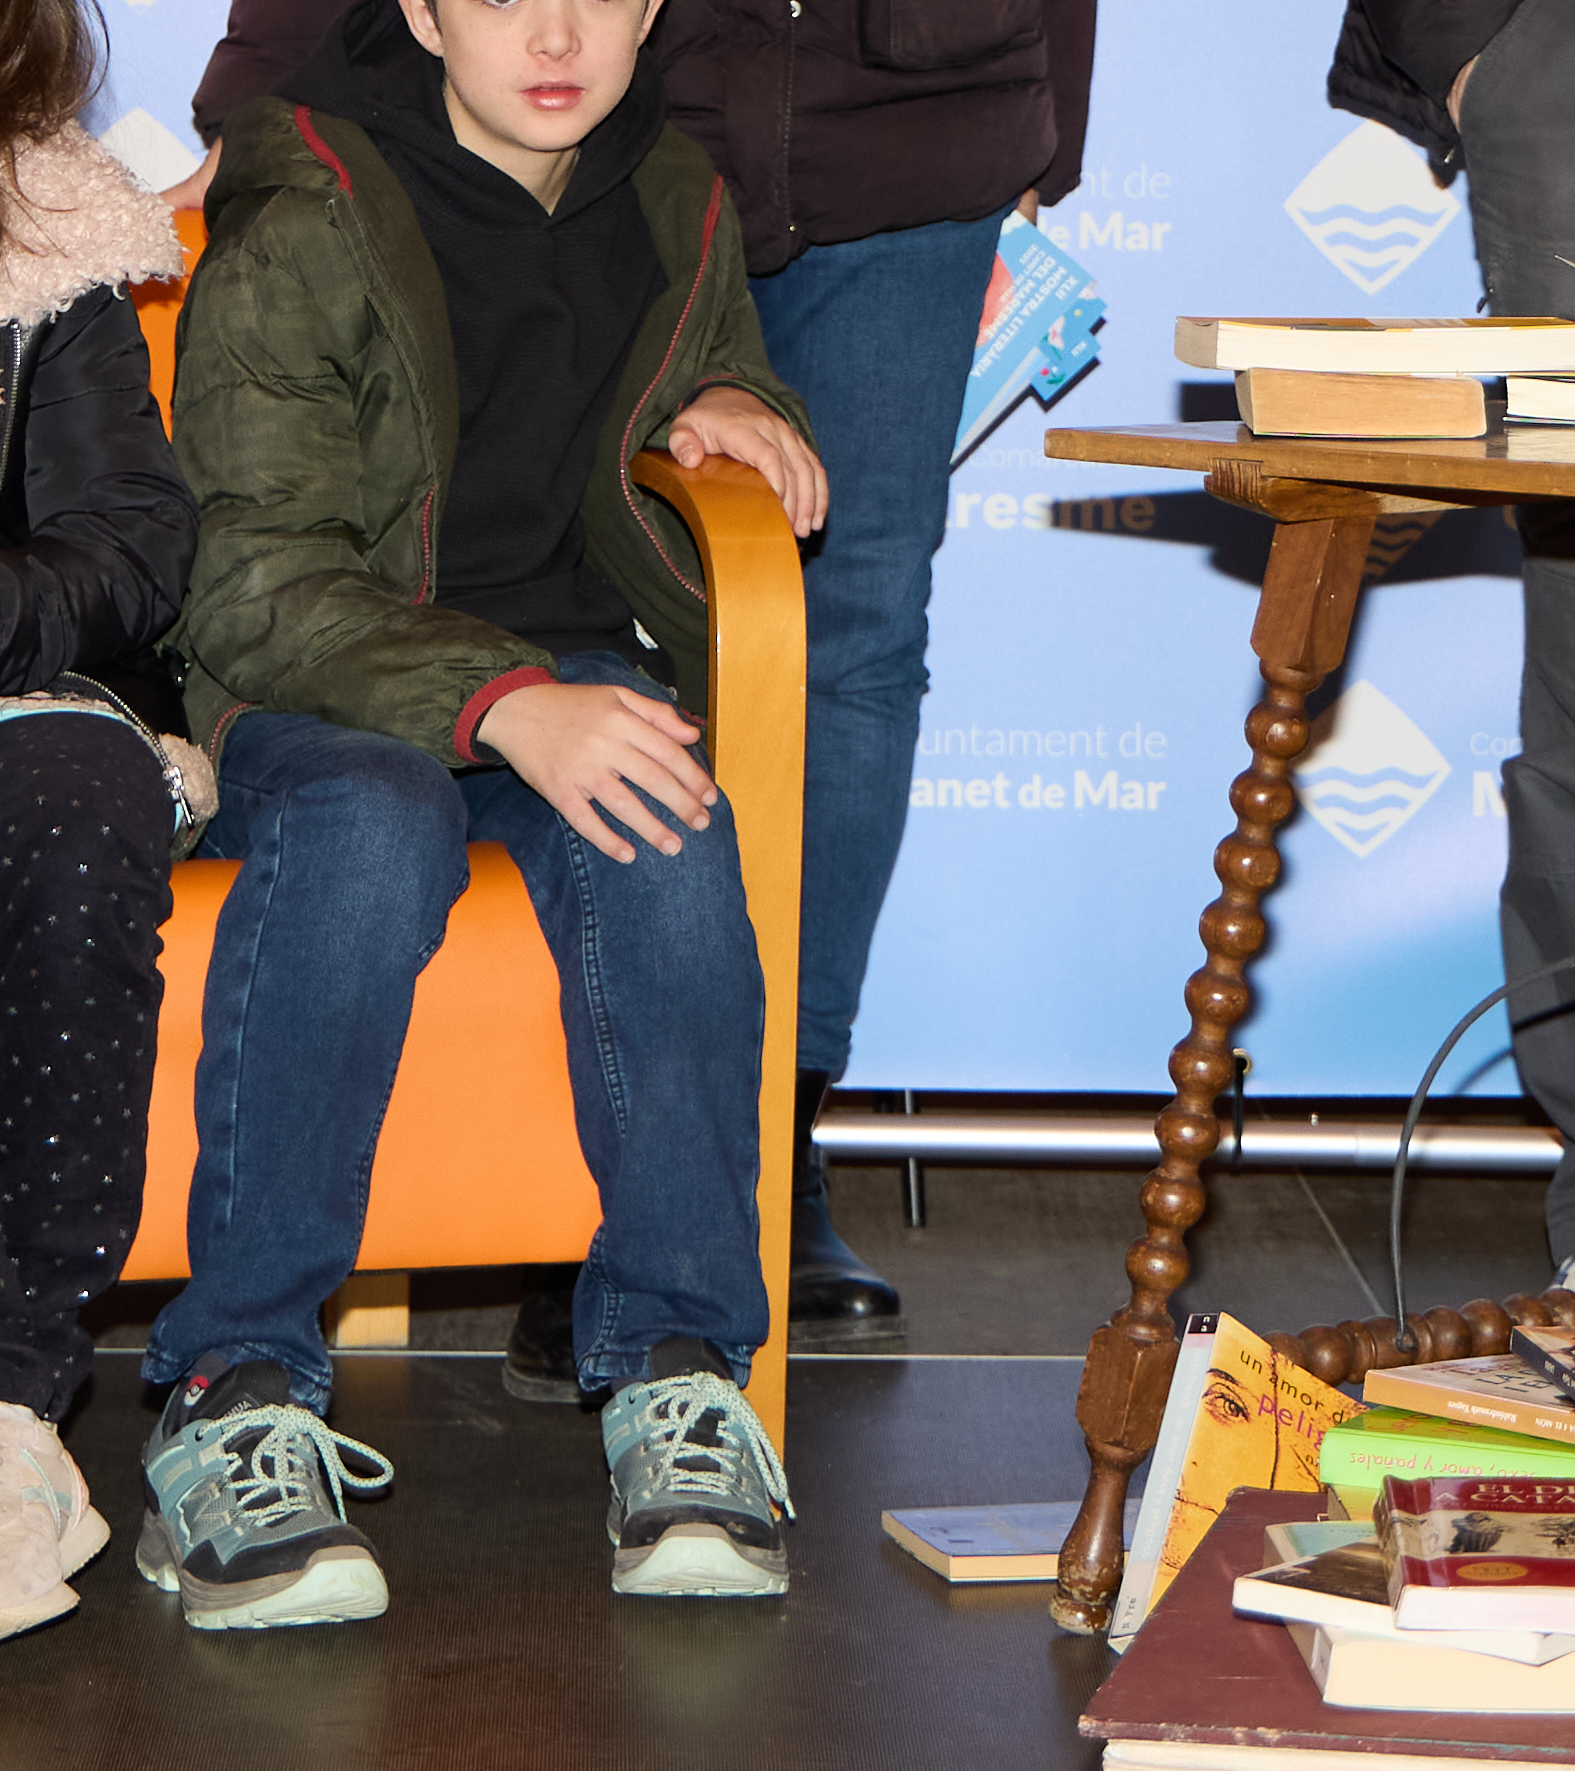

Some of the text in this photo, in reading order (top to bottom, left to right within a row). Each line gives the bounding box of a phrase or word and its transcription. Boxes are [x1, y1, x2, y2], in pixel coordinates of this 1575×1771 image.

[1124, 163, 1172, 199] de
[1078, 211, 1172, 252] Mar
[982, 254, 1056, 339] DEL MARESME
[1018, 264, 1067, 319] MOSTRA
[1118, 722, 1168, 758] de
[909, 770, 1168, 810] anet de Mar
[1241, 1349, 1325, 1413] un amor
[1349, 1451, 1417, 1472] pañales
[1440, 1462, 1483, 1478] amor
[1478, 1483, 1514, 1495] EL
